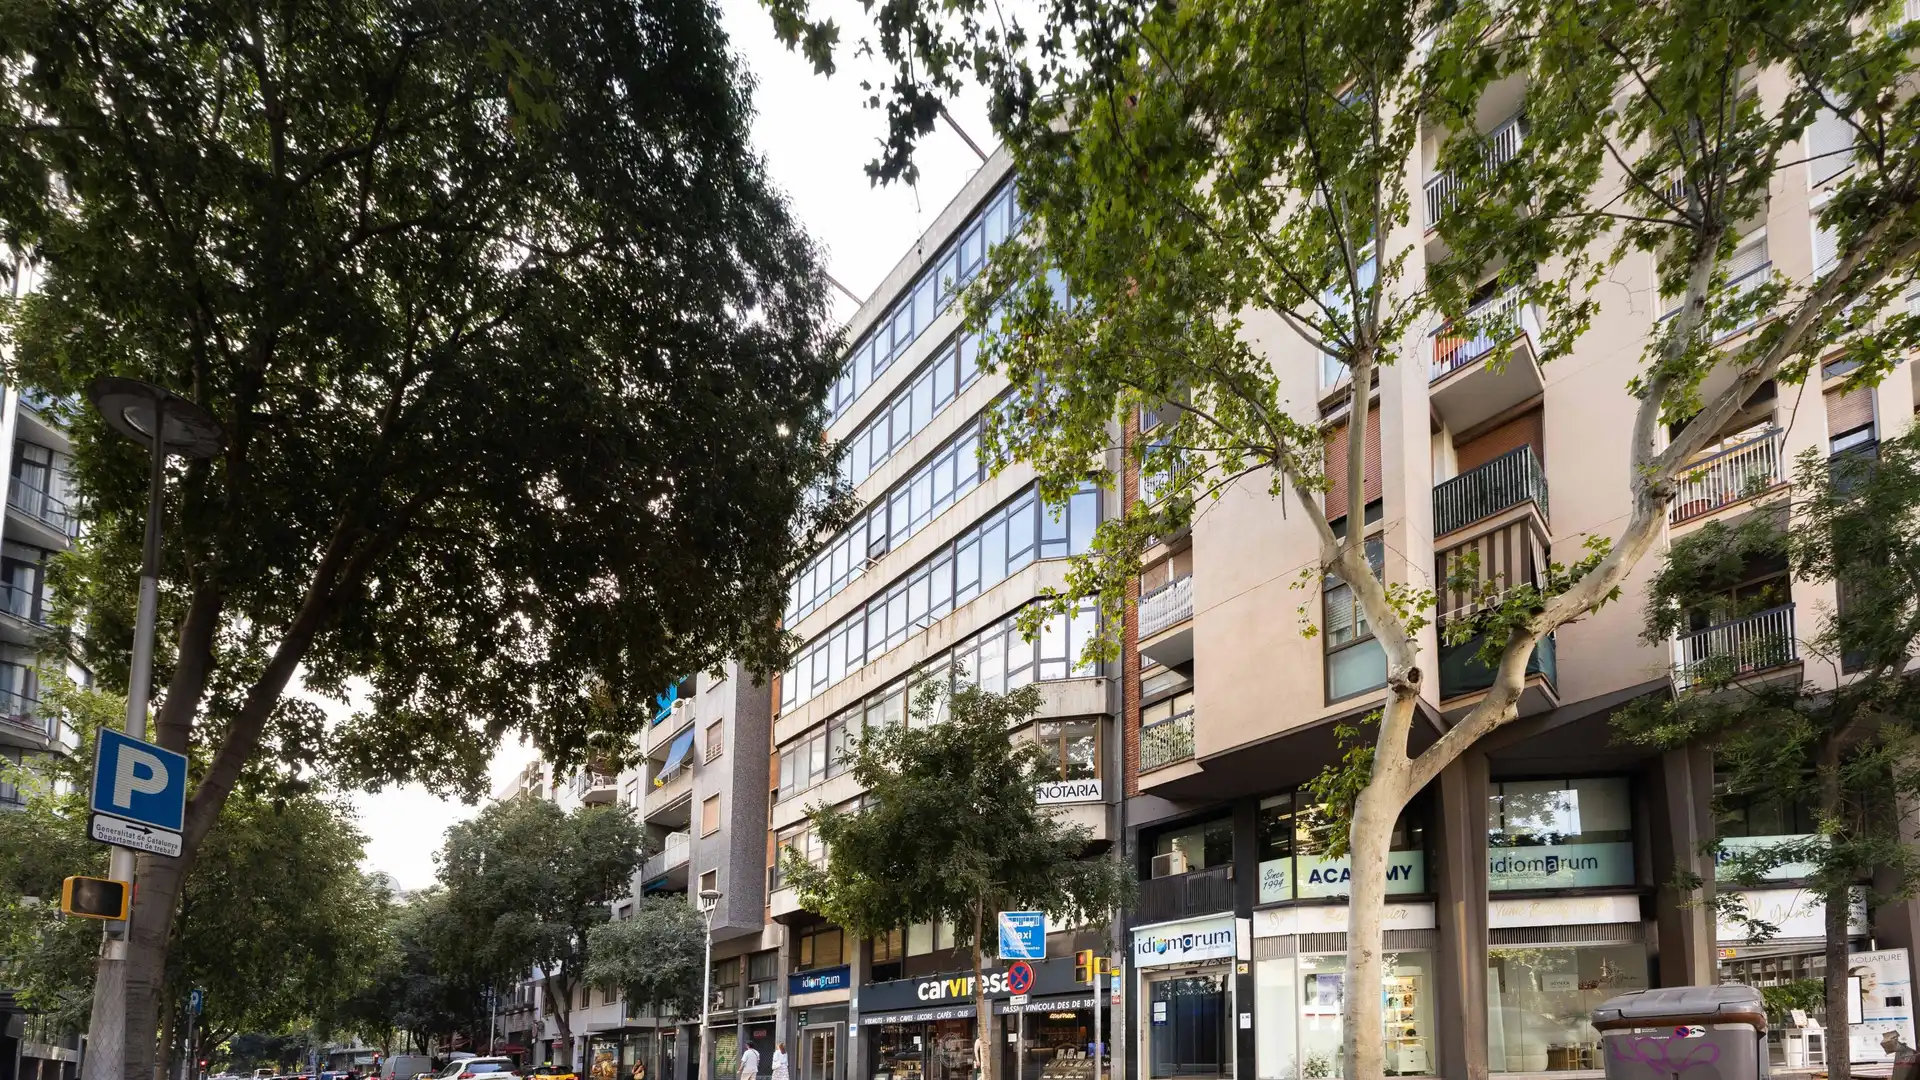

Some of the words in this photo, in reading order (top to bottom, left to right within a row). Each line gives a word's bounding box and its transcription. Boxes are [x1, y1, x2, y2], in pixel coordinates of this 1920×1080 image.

[113, 743, 169, 809] P
[1038, 783, 1099, 799] NOTARIA
[96, 823, 135, 839] Generalitat
[137, 833, 145, 841] de
[147, 836, 178, 850] Catalunya
[98, 831, 143, 848] Departament
[145, 842, 153, 850] de
[154, 845, 176, 855] treball
[1264, 868, 1285, 881] Since
[1309, 865, 1412, 884] ACAMY
[1490, 856, 1598, 876] idiomarum
[1263, 878, 1285, 890] 1994
[1014, 930, 1032, 939] axi
[1025, 1002, 1055, 1011] VINÍCOLA
[1057, 1001, 1070, 1009] DES
